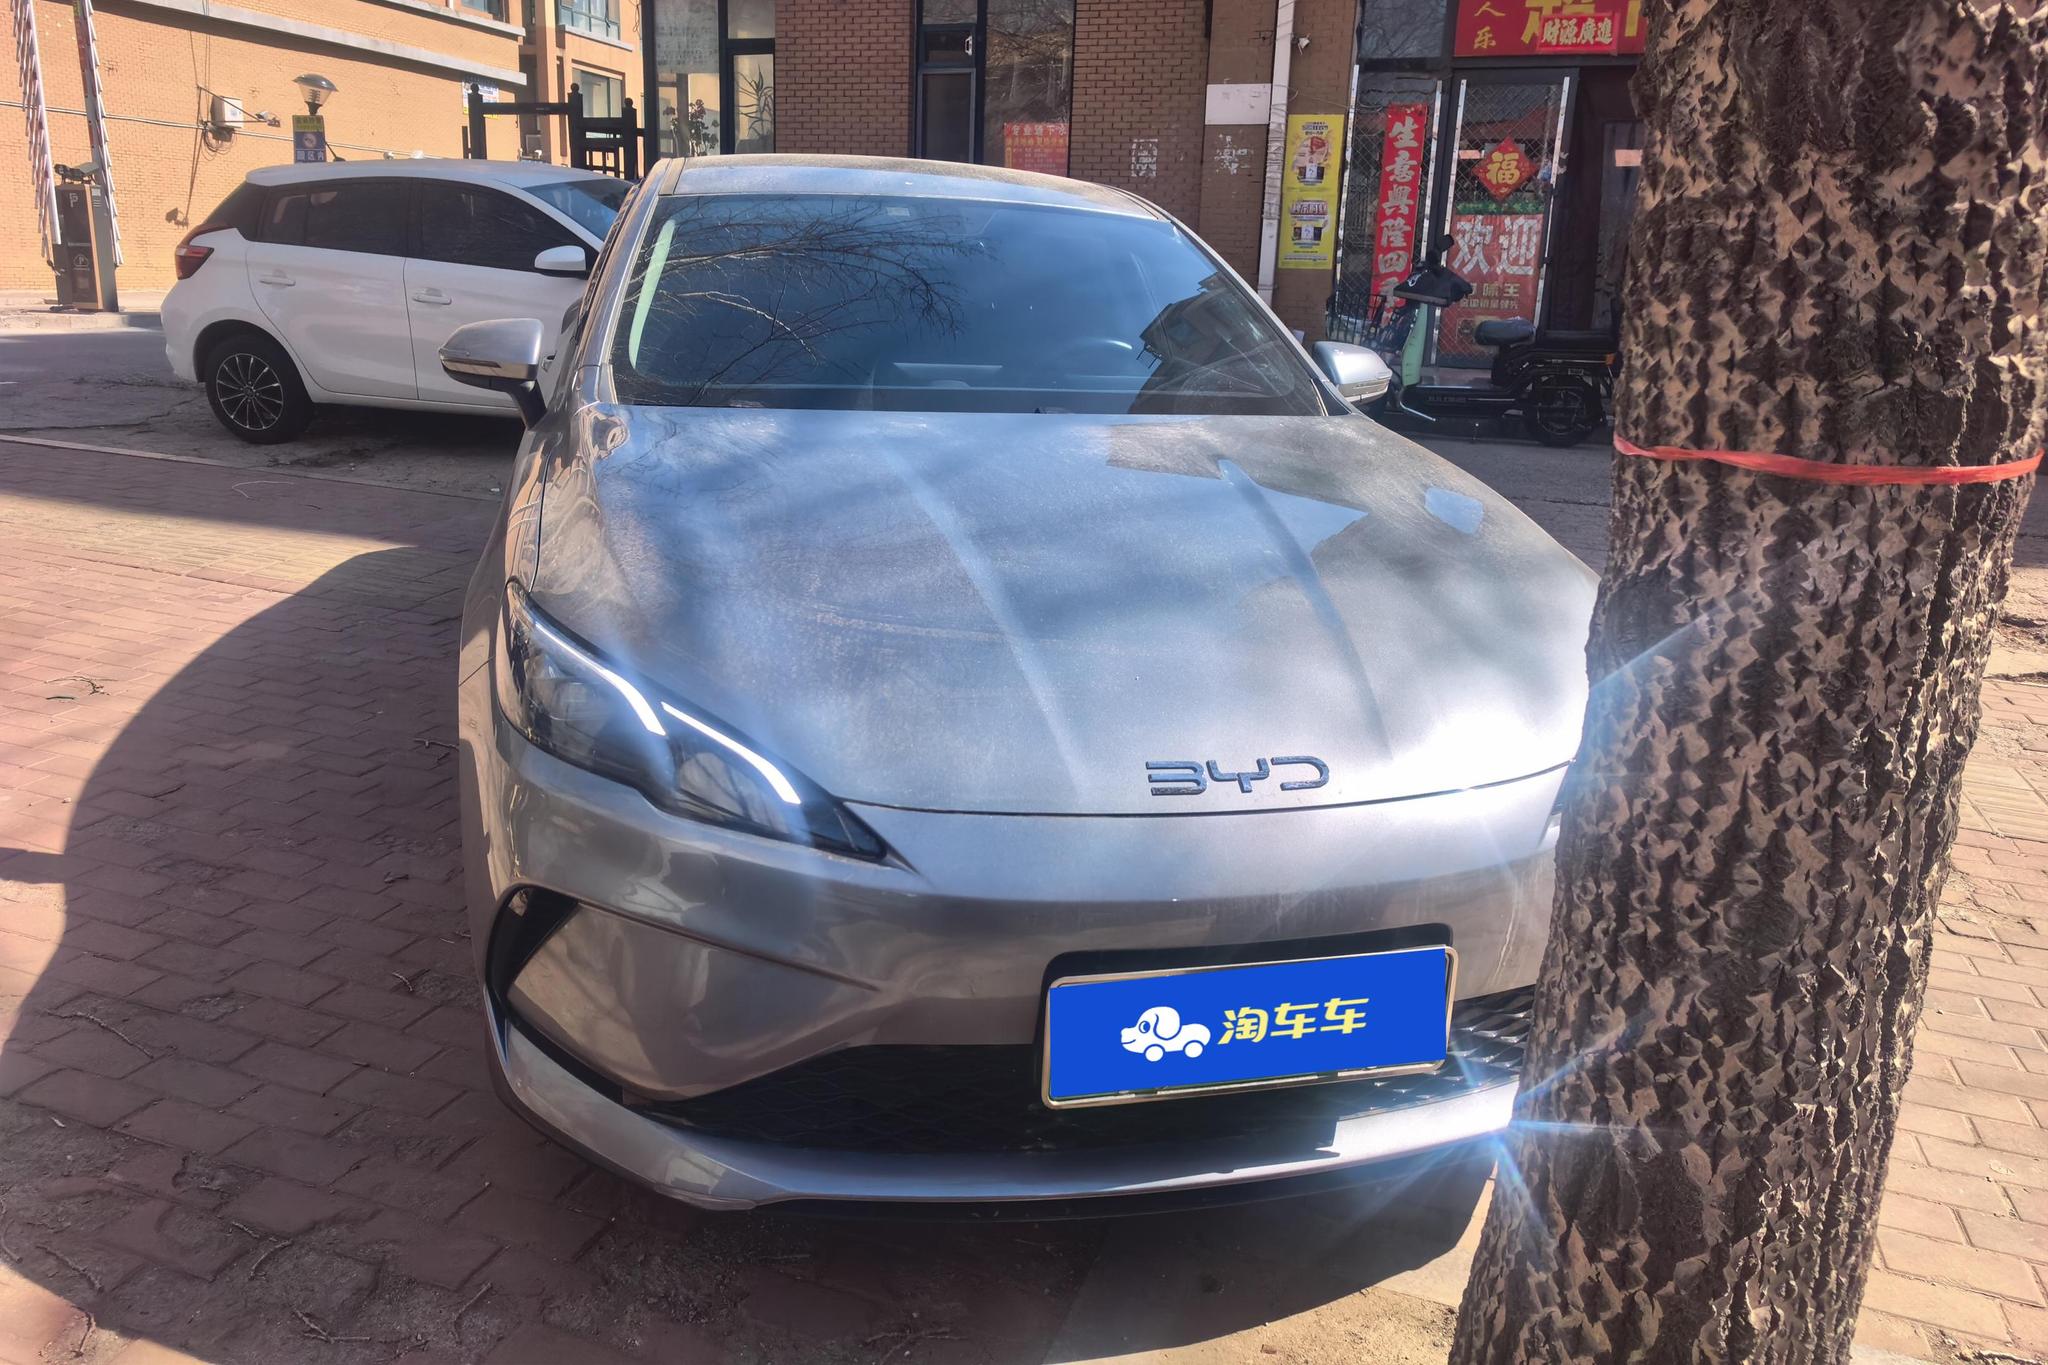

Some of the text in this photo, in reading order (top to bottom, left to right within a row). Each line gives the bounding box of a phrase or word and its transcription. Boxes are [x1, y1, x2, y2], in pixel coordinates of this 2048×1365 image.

[1487, 151, 1521, 184] 福
[1452, 216, 1540, 275] 欢迎
[1145, 755, 1330, 796] BYD
